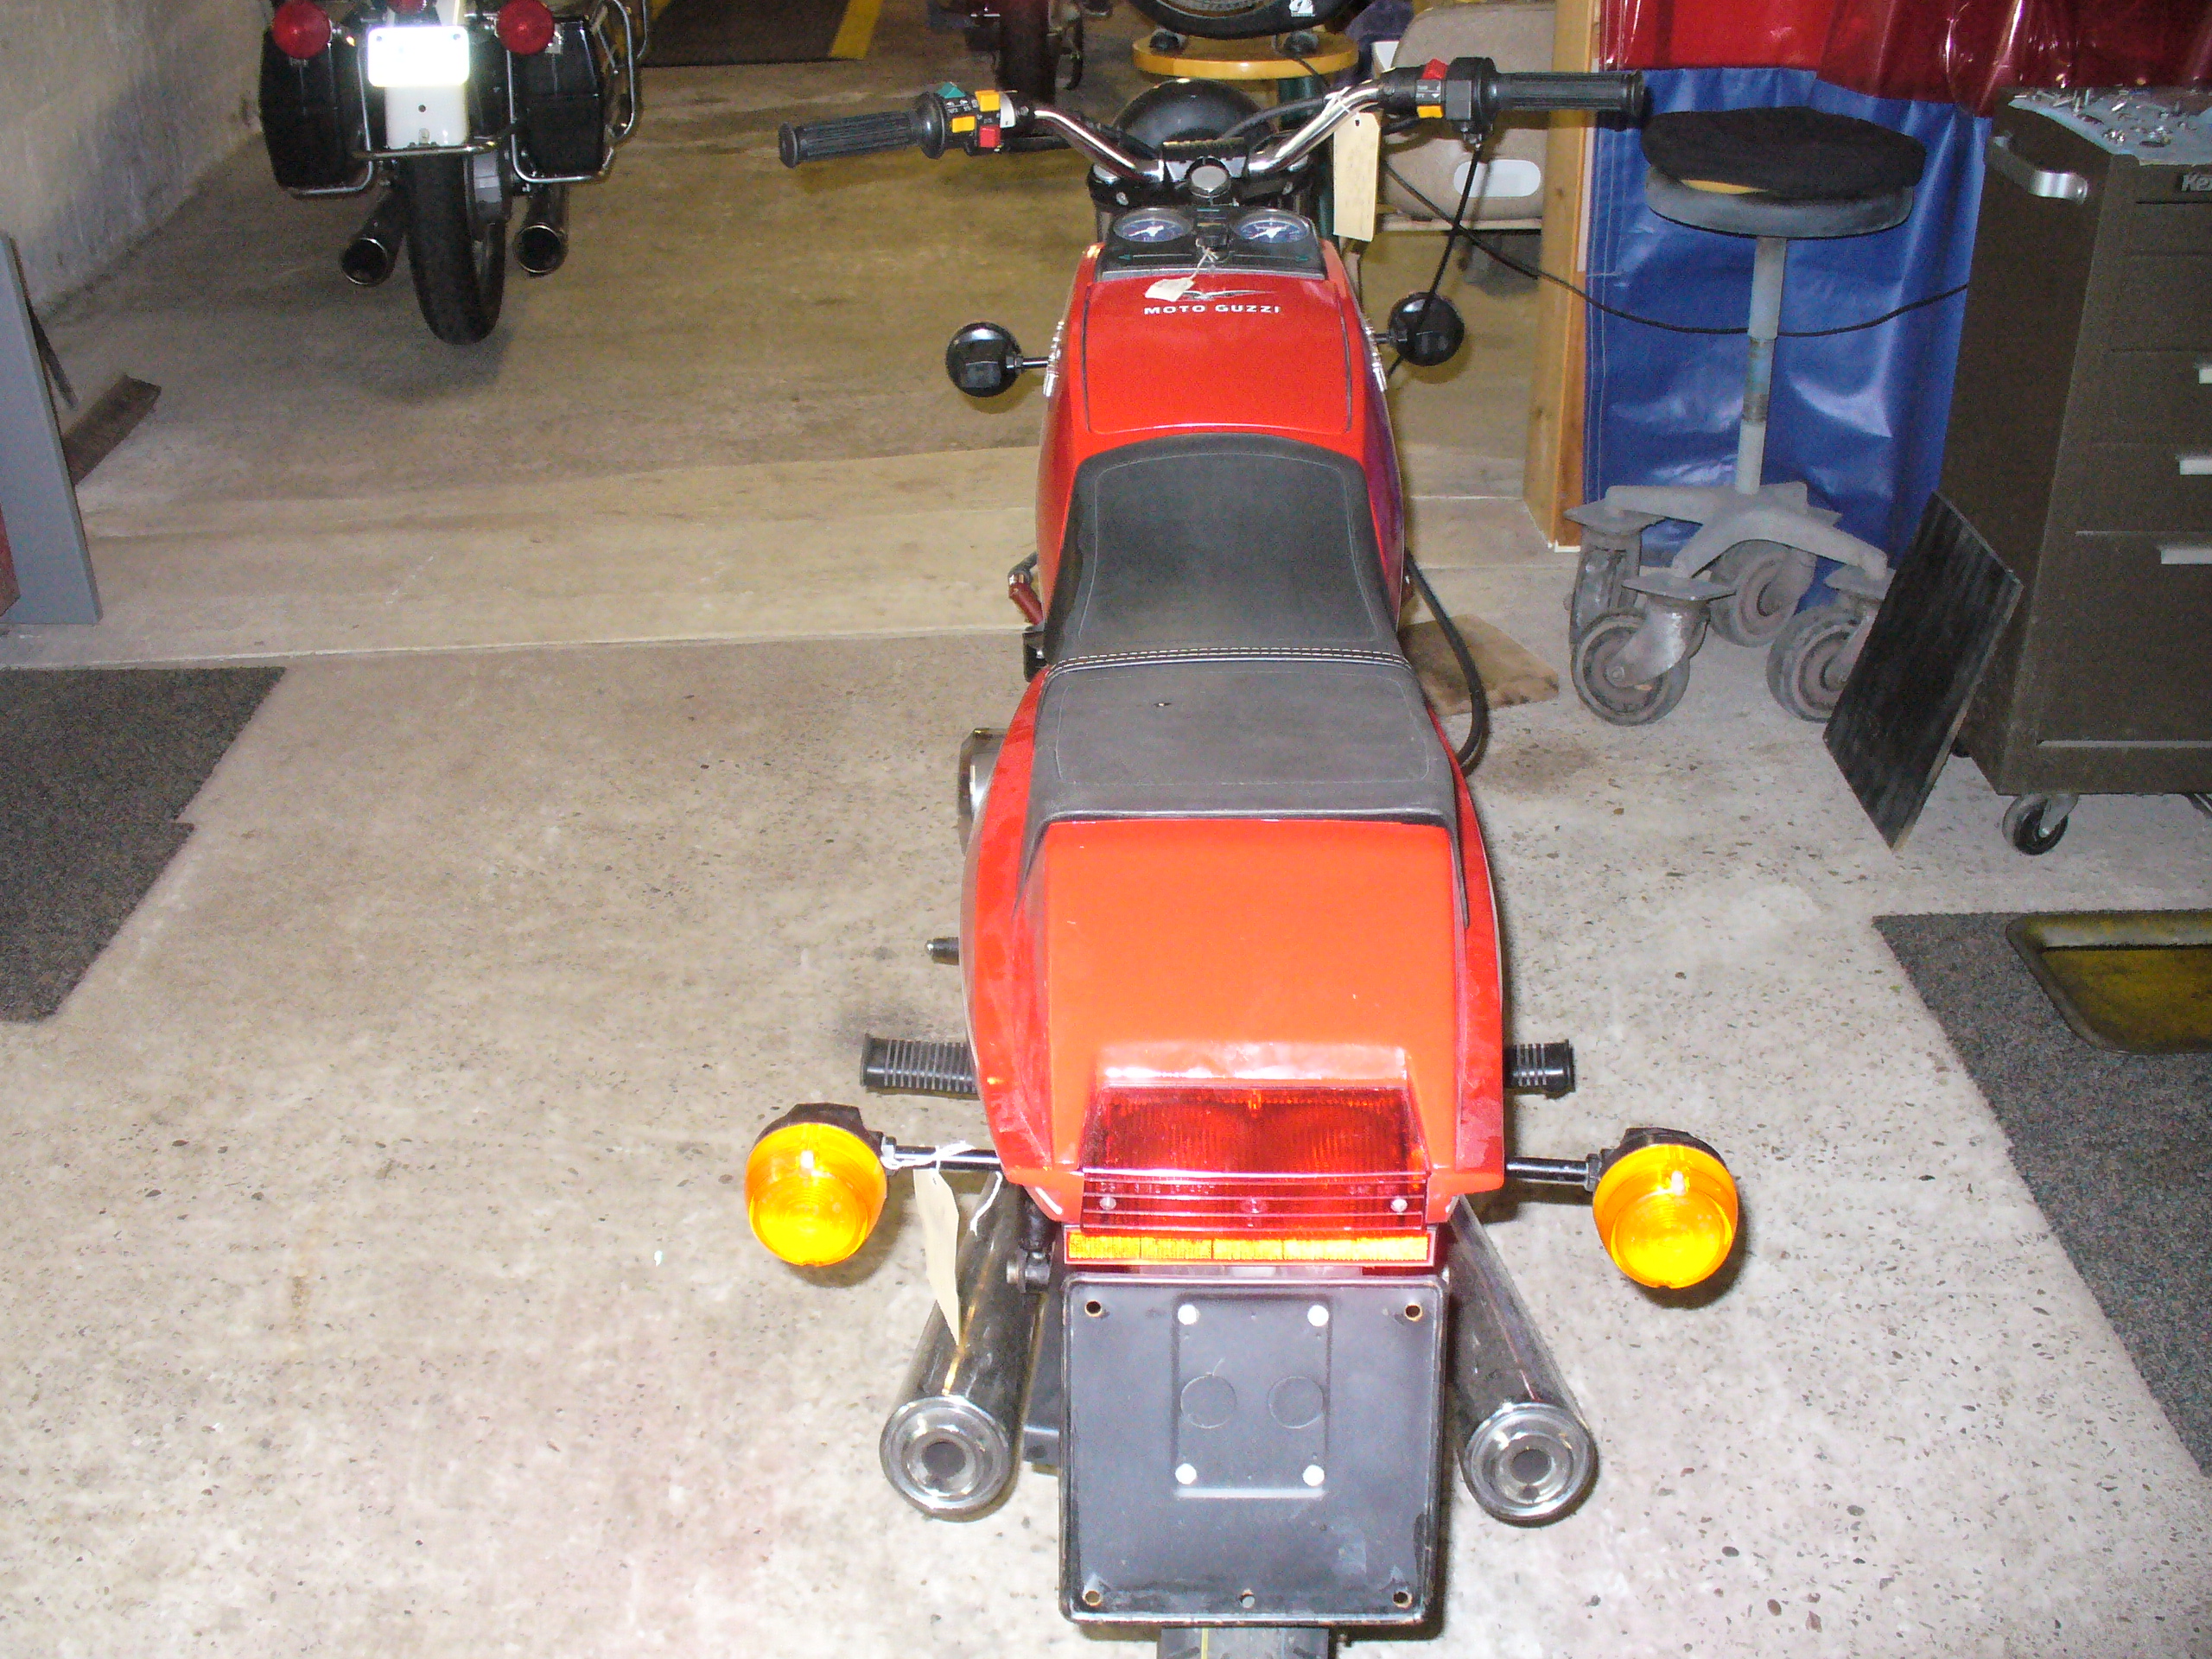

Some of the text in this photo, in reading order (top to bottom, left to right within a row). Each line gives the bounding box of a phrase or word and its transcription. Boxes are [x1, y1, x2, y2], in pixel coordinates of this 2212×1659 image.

[2181, 173, 2212, 191] Ke
[1143, 304, 1281, 315] MOTO GUZZI
